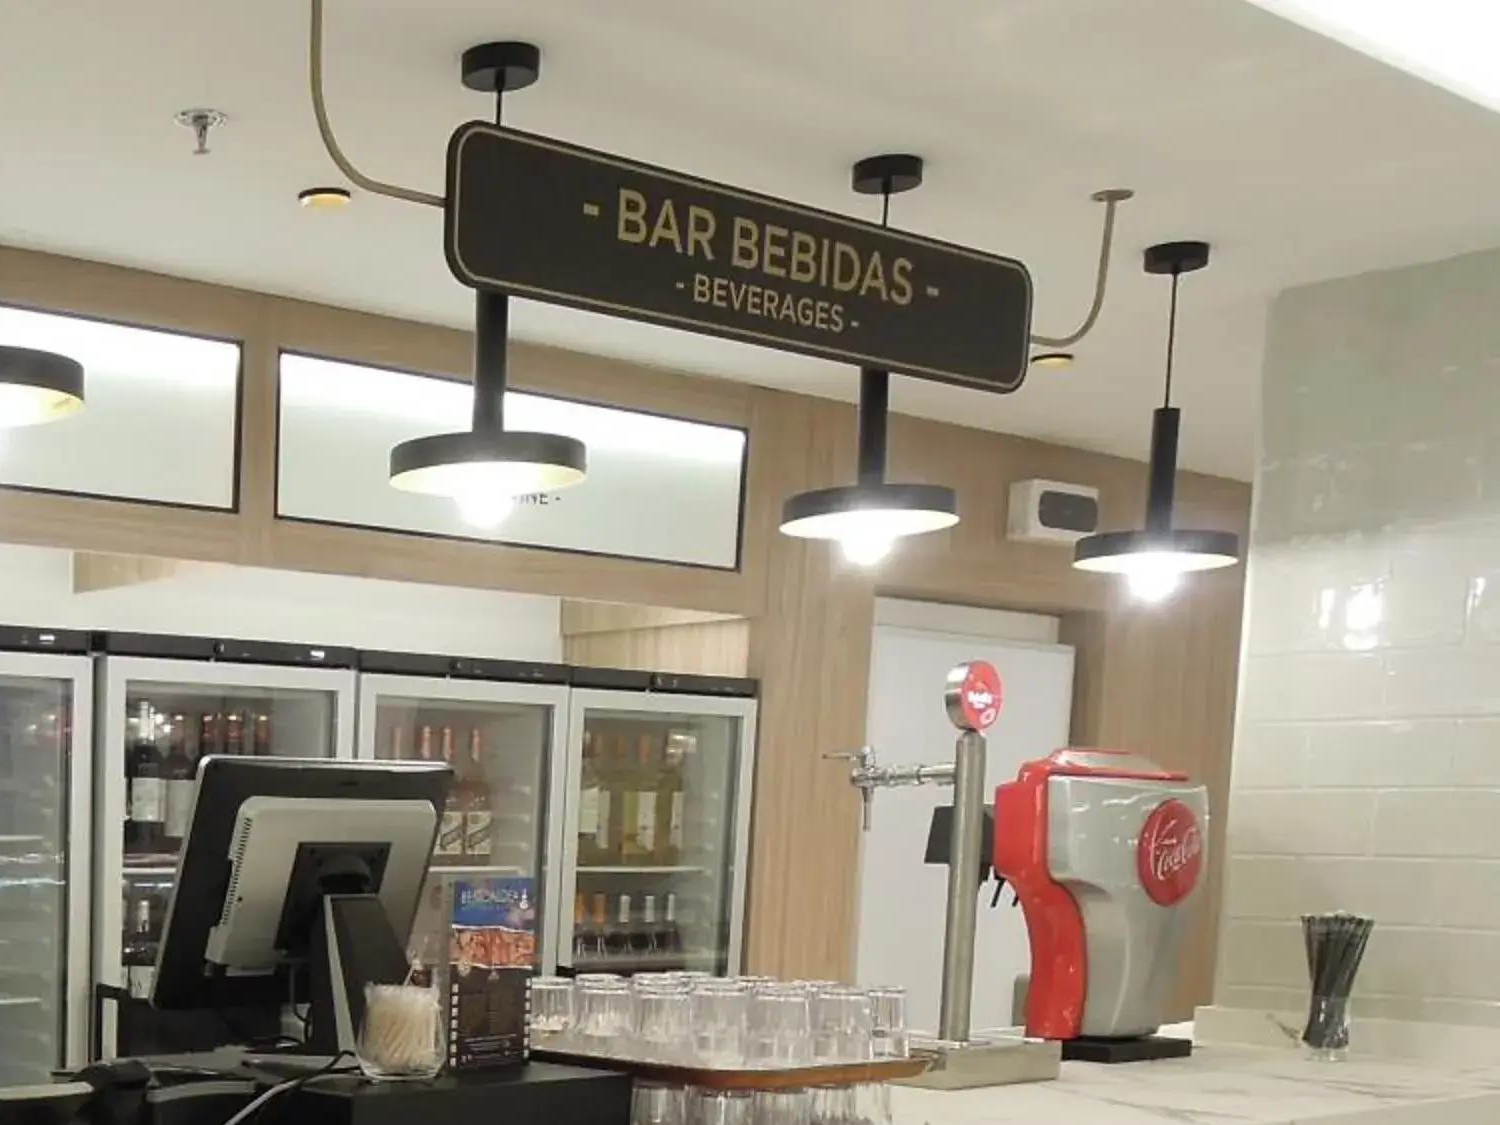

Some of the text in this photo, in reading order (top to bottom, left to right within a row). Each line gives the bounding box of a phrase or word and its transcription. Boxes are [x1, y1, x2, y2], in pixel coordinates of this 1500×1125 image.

[617, 187, 716, 261] BAR
[731, 216, 916, 306] BEBIDAS
[693, 273, 845, 333] BEVERAGES
